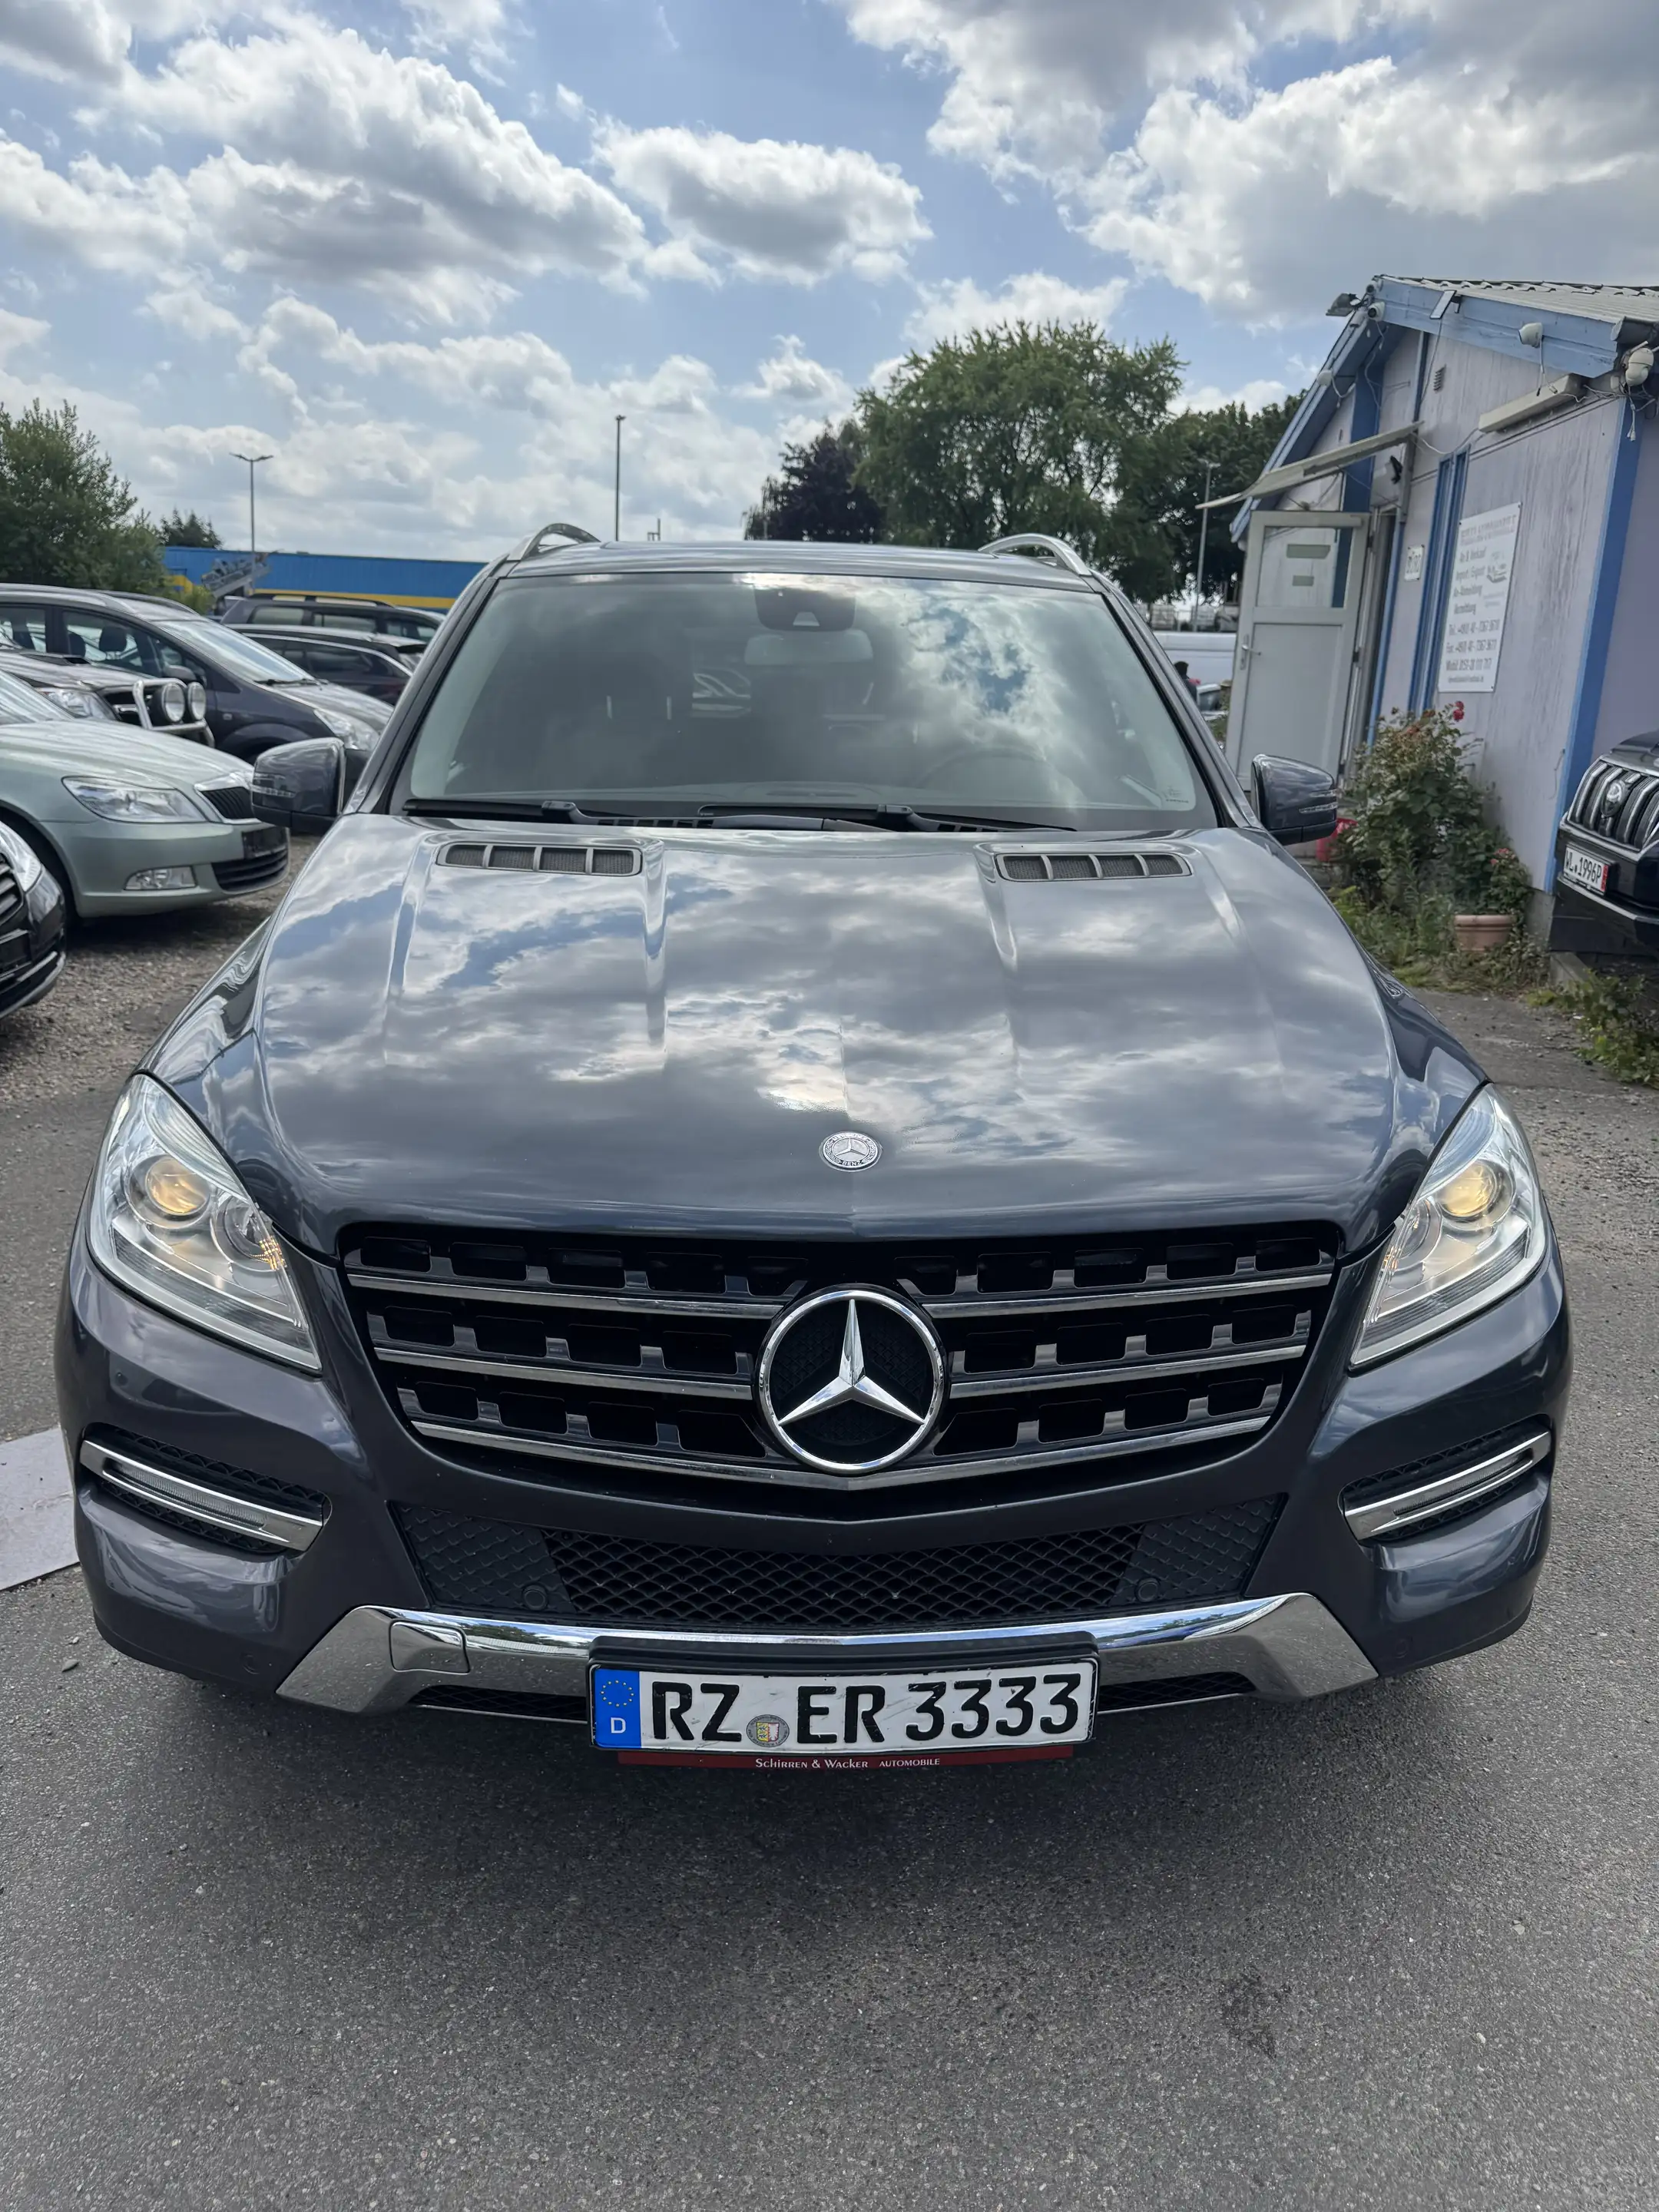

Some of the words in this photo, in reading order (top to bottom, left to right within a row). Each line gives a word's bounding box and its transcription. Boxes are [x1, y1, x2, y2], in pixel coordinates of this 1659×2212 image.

[611, 1717, 627, 1734] D
[651, 1681, 743, 1742] RZ
[796, 1685, 886, 1743] ER
[905, 1672, 1081, 1741] 3333
[811, 1759, 821, 1769] &
